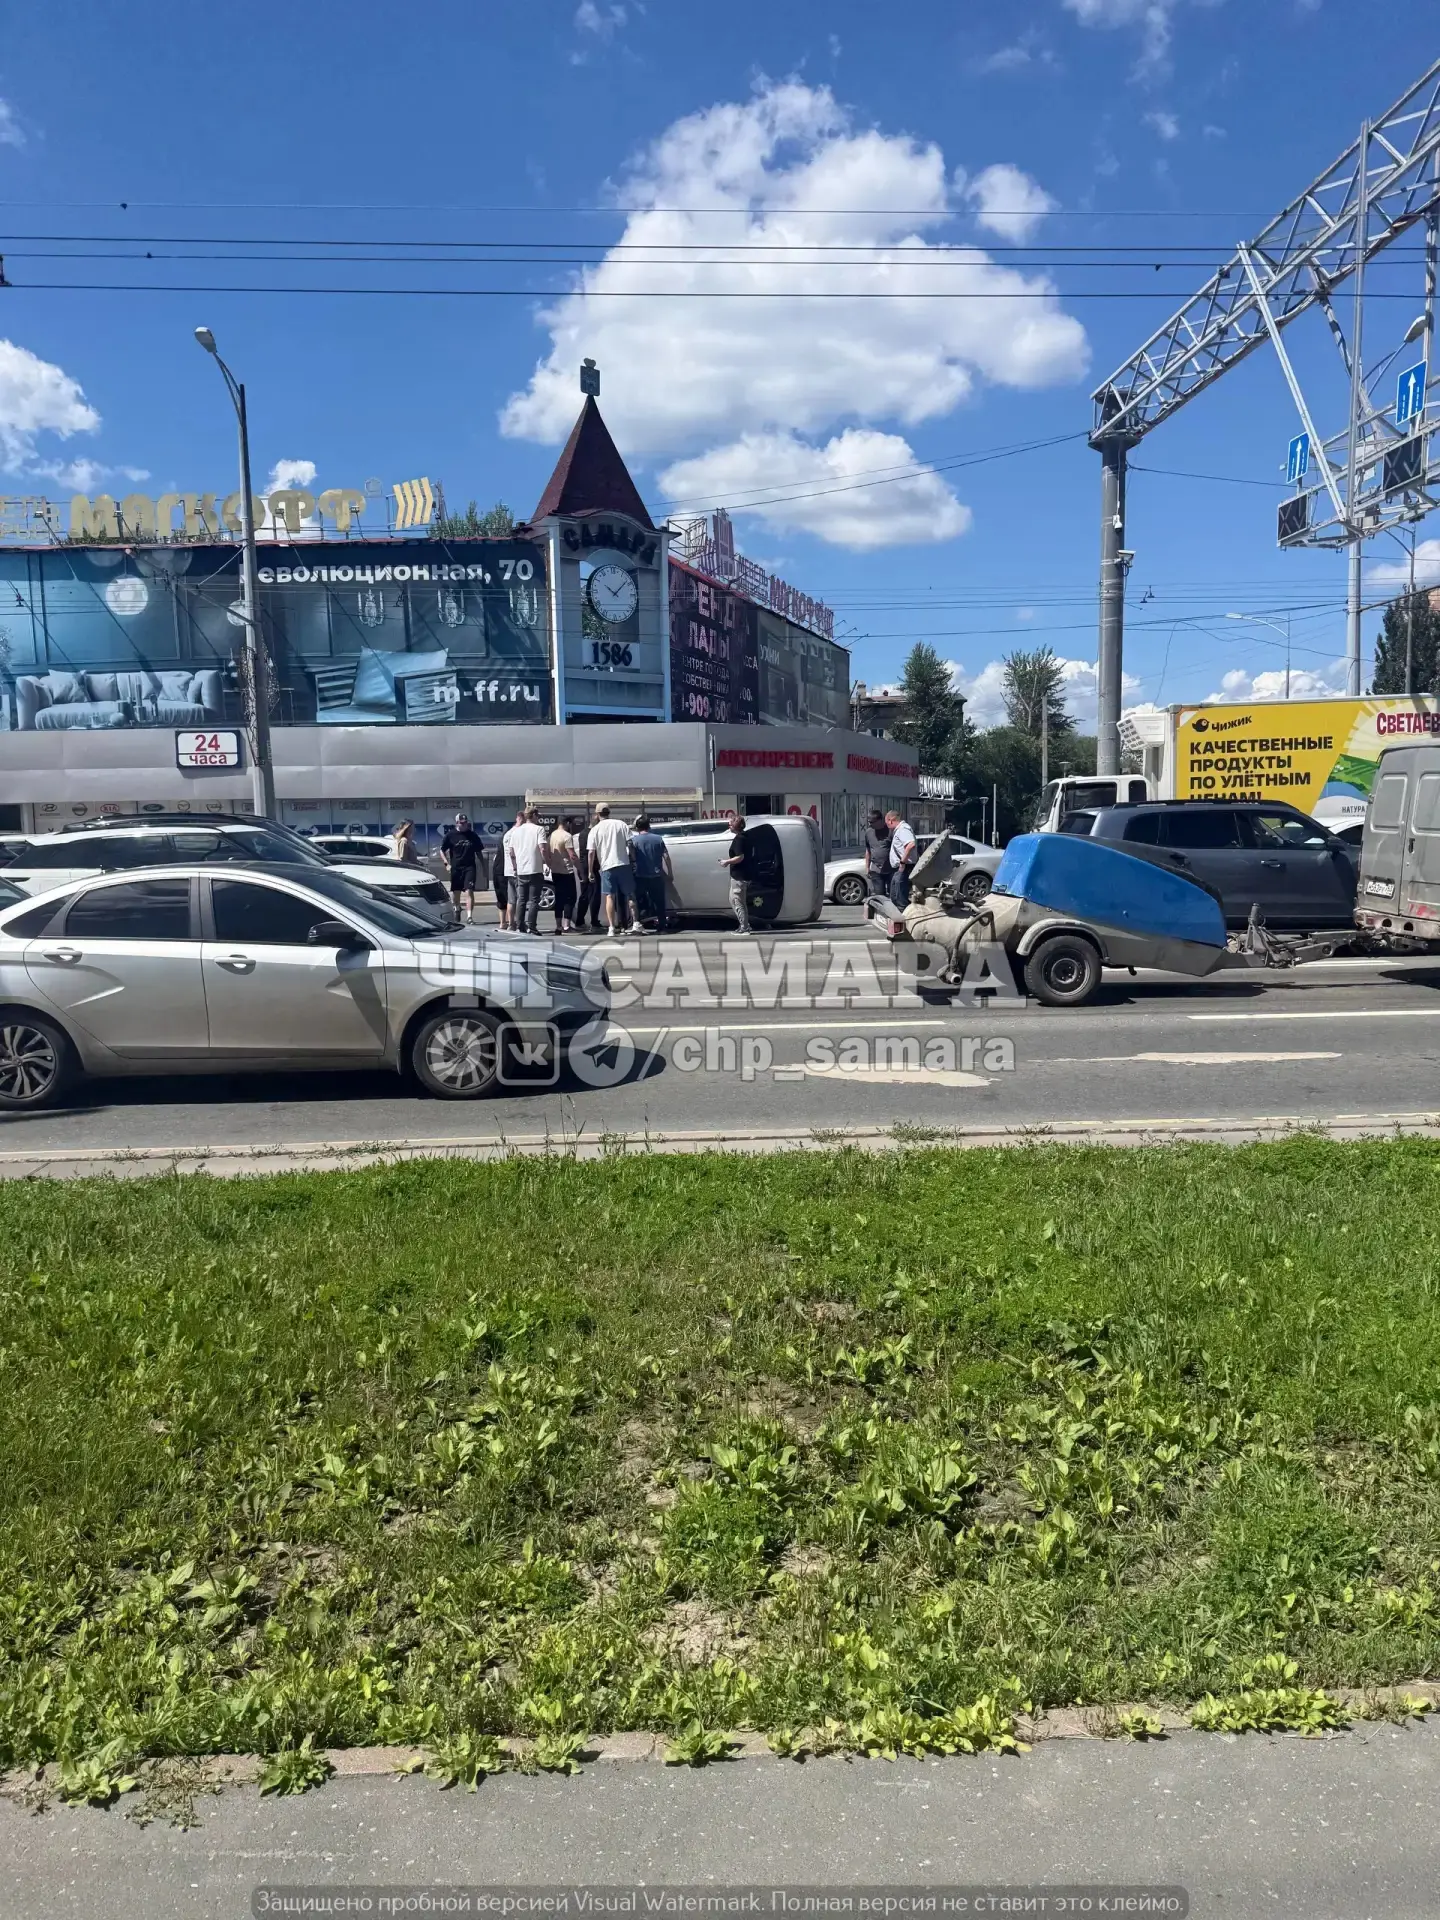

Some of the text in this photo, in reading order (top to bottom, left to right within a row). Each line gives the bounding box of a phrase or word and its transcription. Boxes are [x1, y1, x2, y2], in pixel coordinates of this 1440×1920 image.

[239, 557, 534, 584] еволюционная, 70
[592, 641, 633, 667] 1586
[433, 678, 541, 703] m-ff.ru
[194, 733, 221, 753] 24
[1190, 736, 1334, 755] КАЧЕСТВЕННЫЕ
[189, 753, 229, 766] часа
[1190, 755, 1292, 773] ПРОДУКТЫ
[1190, 770, 1311, 790] ПО УЛЁТНЫМ
